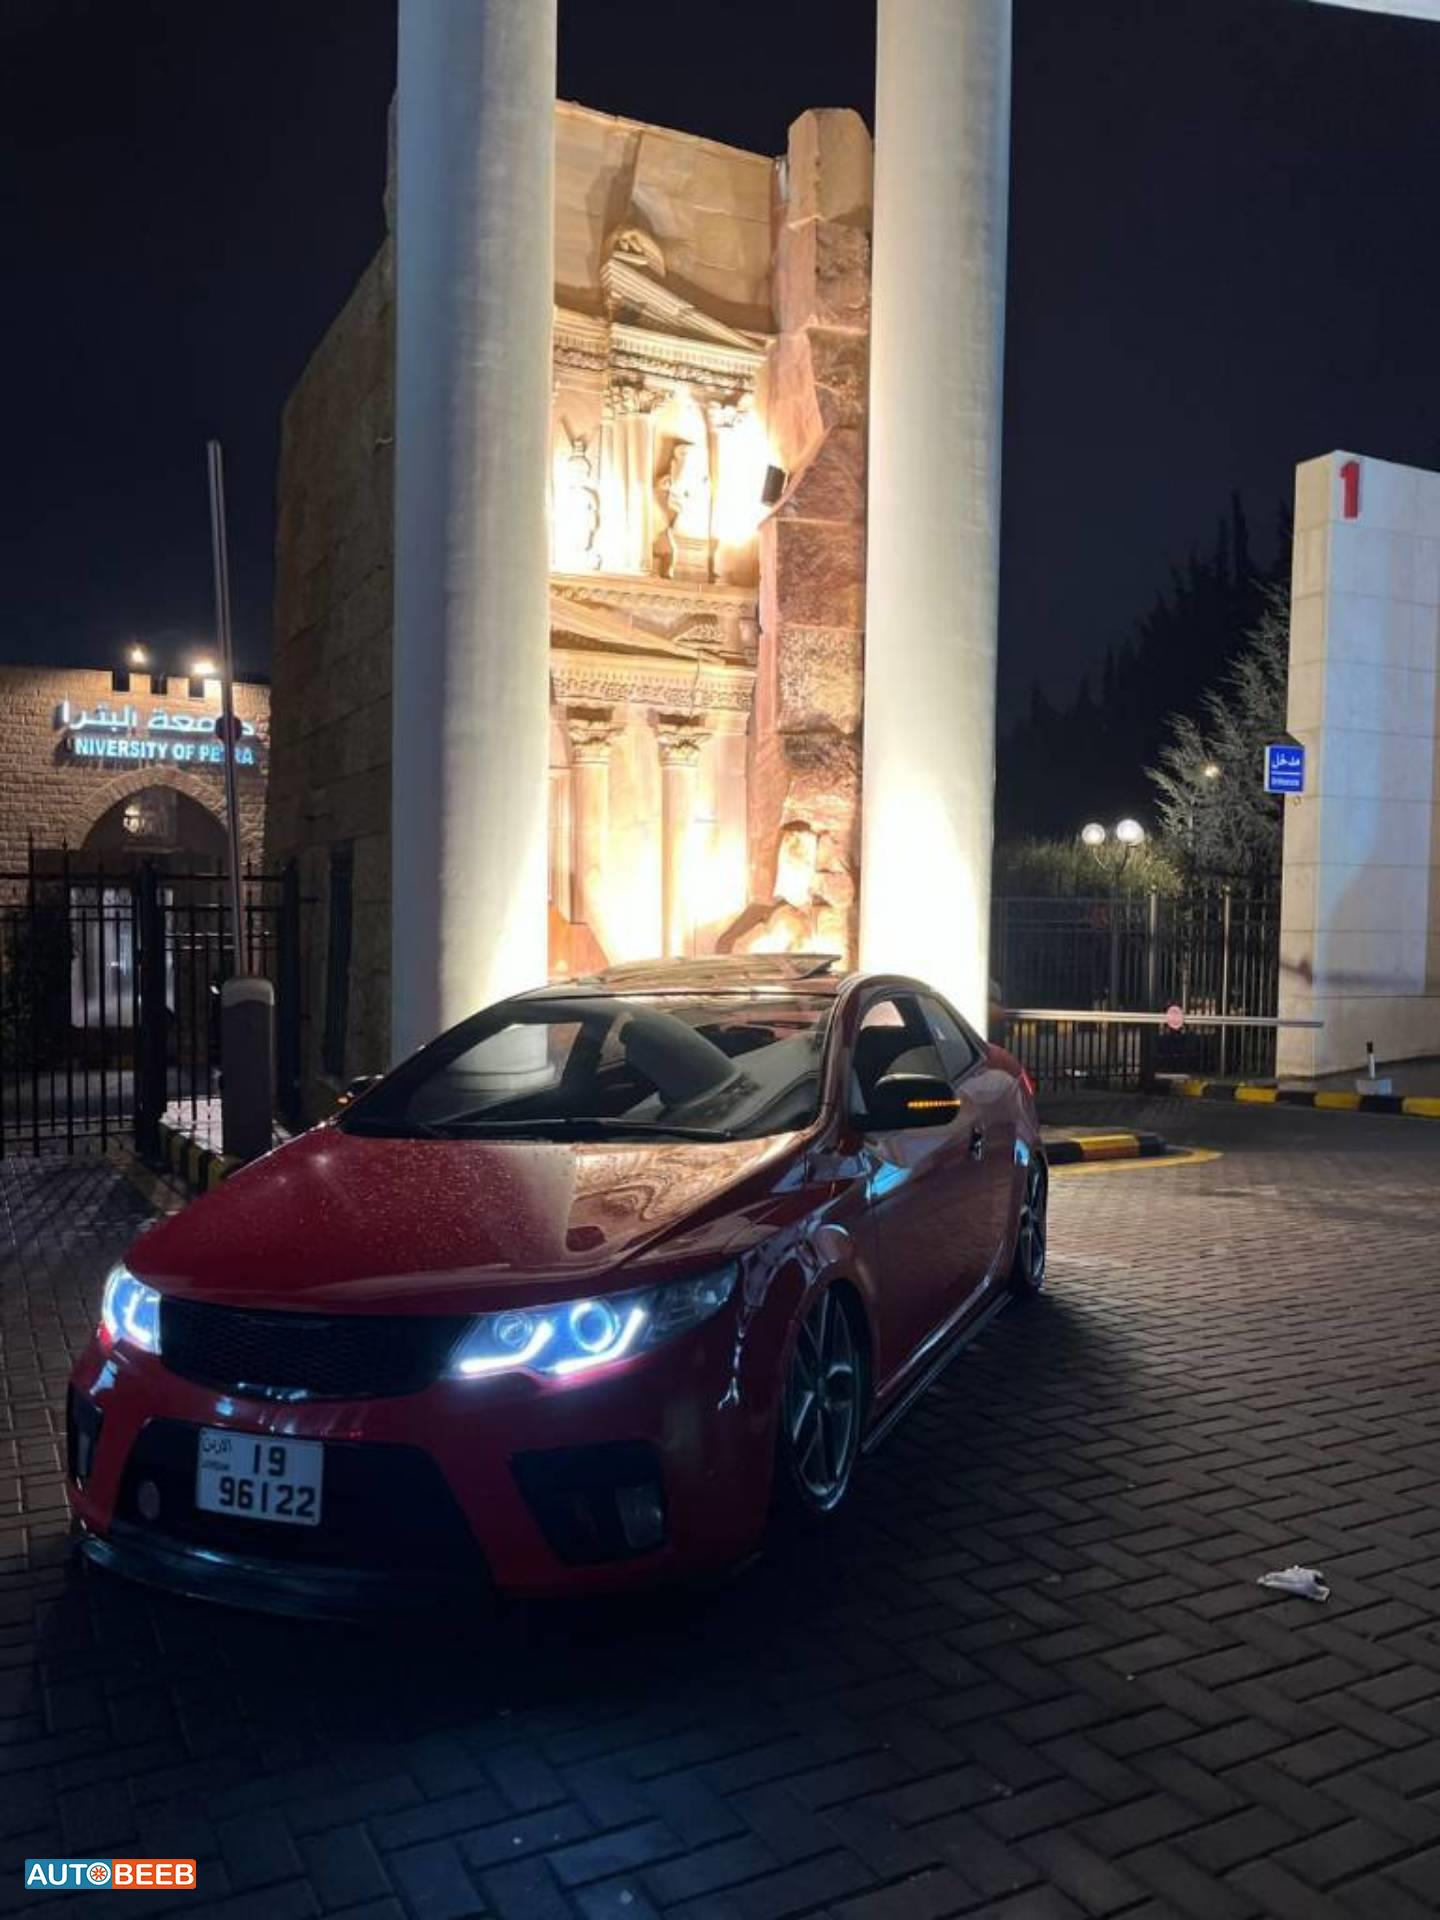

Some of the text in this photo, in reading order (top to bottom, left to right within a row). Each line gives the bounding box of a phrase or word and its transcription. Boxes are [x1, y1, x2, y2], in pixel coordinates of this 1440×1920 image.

[1340, 460, 1361, 519] 1
[173, 743, 193, 760] OF
[1271, 751, 1300, 769] مدخل
[252, 1444, 286, 1477] 19
[219, 1476, 316, 1518] 96122
